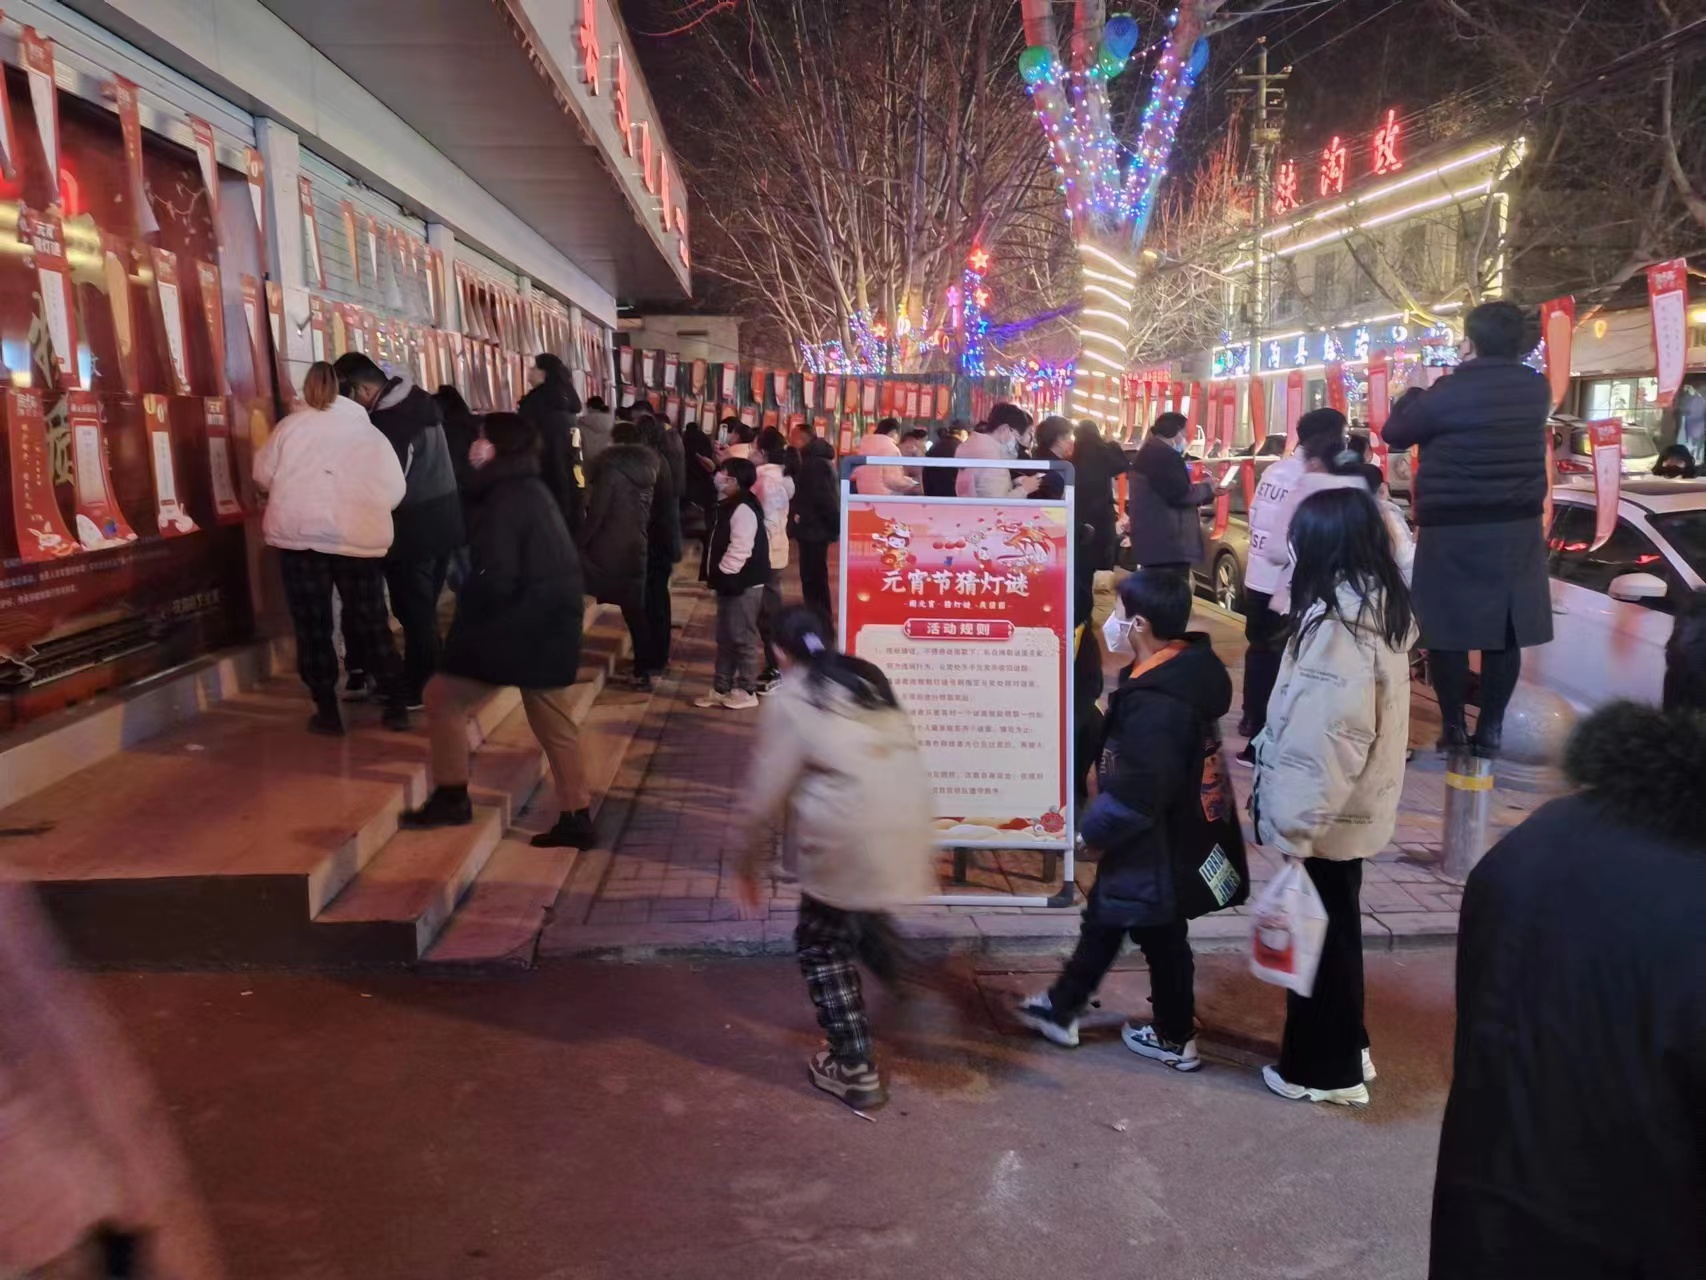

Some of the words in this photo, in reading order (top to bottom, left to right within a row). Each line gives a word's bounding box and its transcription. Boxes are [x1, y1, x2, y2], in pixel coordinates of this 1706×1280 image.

[881, 568, 1030, 597] 元宵节猜灯谜
[926, 622, 990, 636] 活动规则
